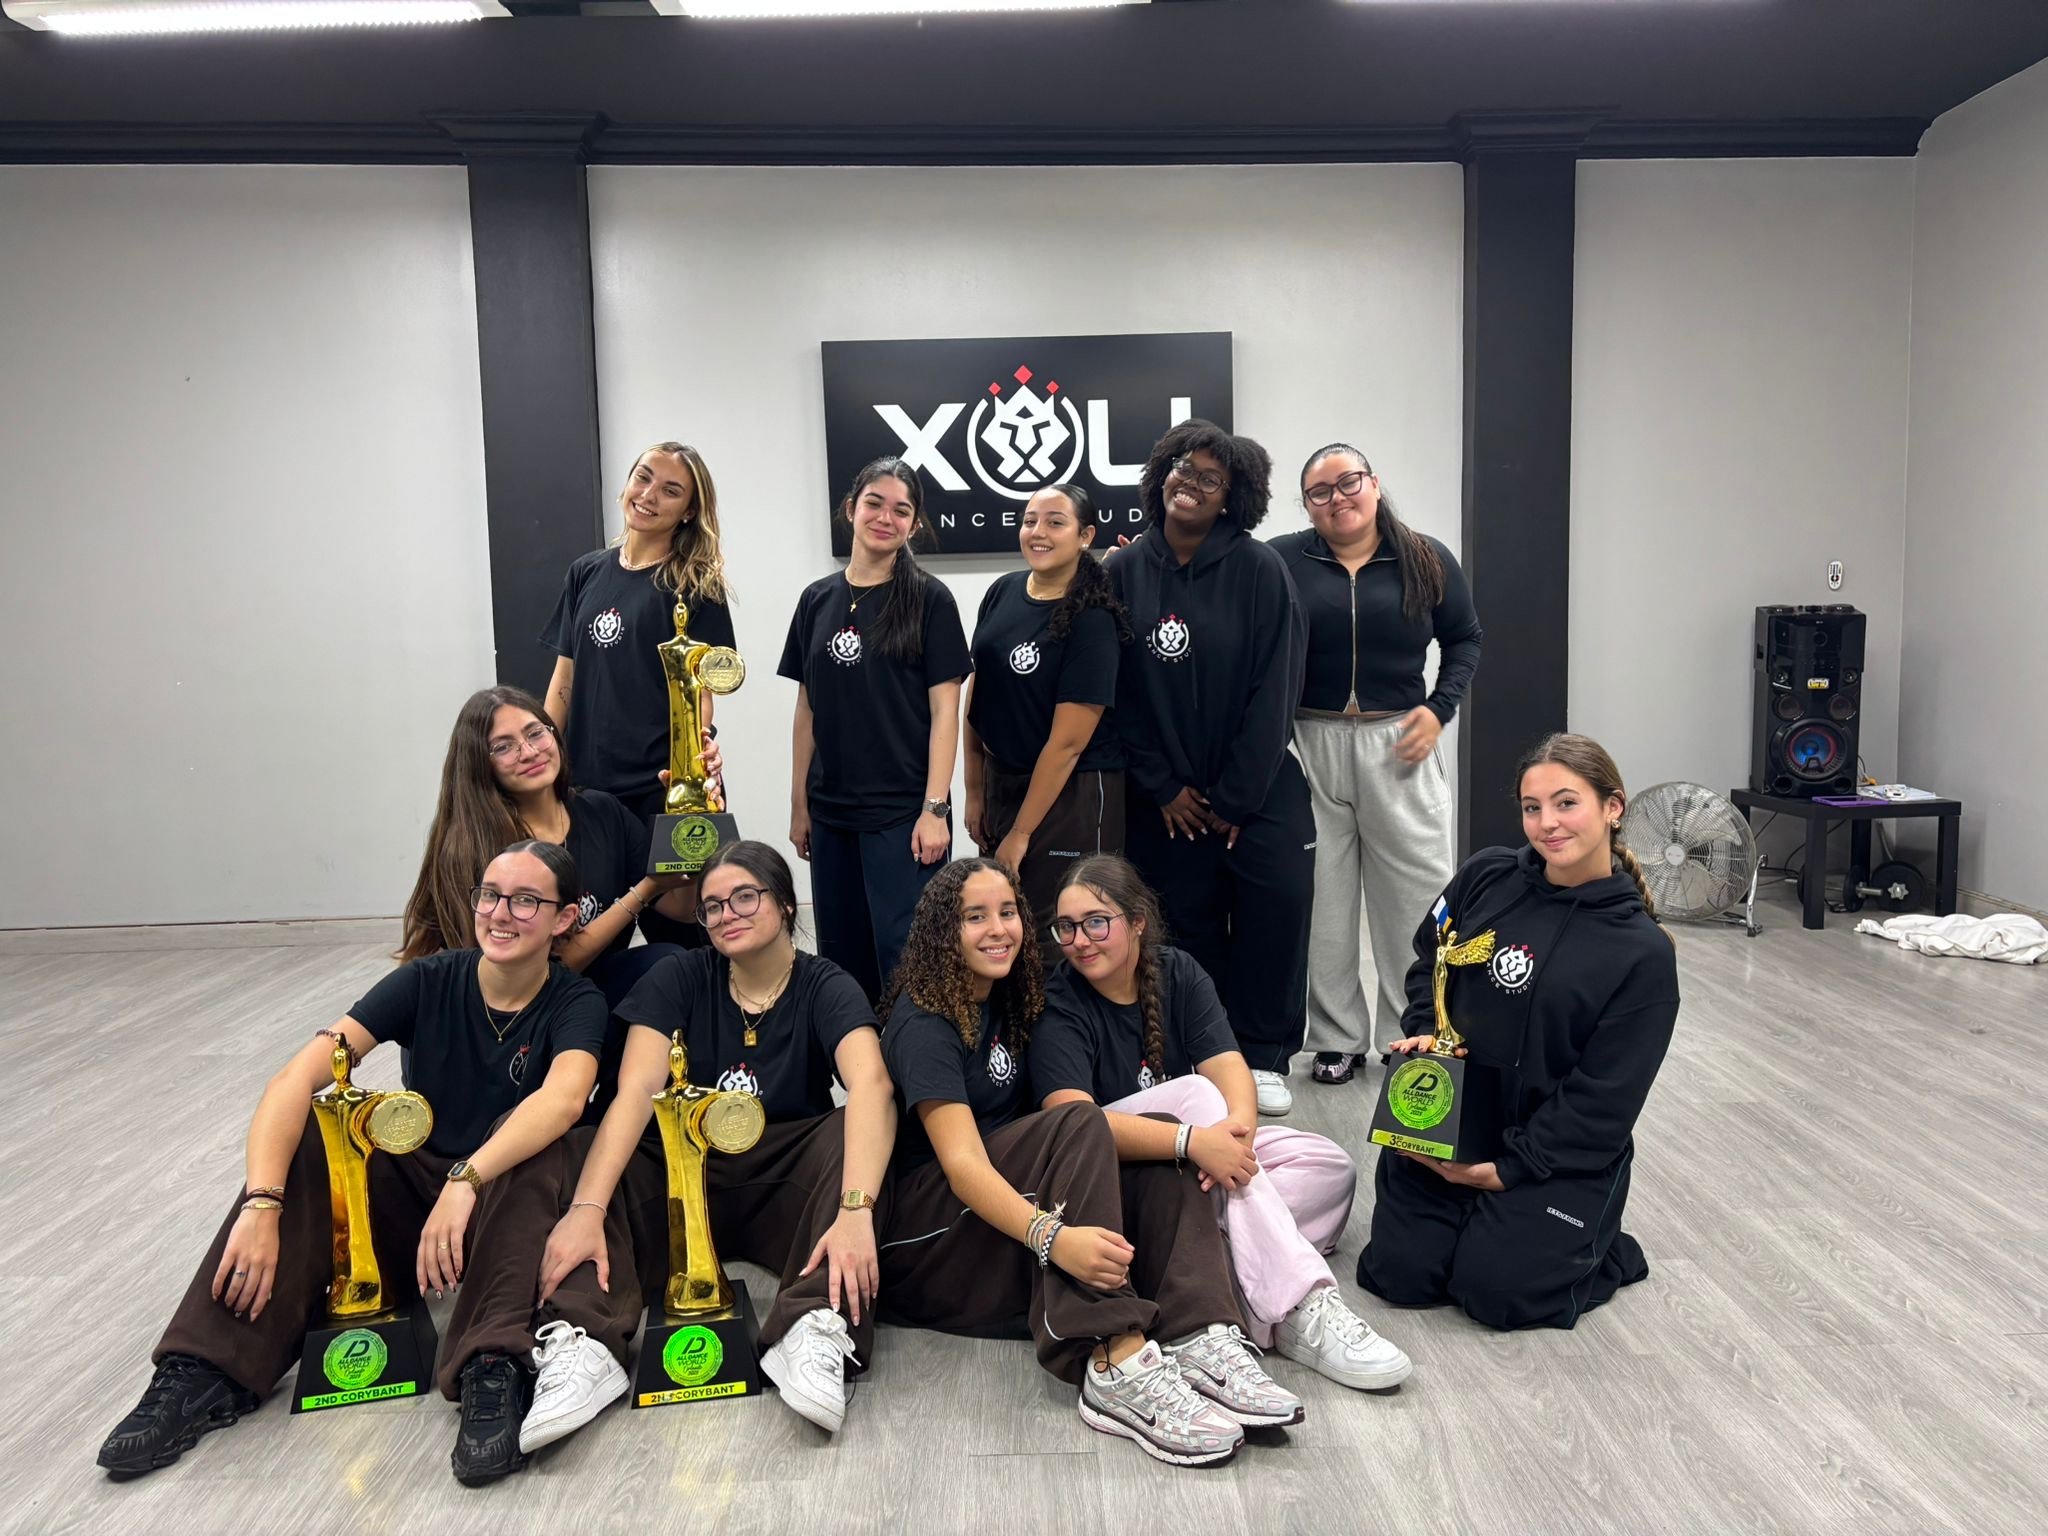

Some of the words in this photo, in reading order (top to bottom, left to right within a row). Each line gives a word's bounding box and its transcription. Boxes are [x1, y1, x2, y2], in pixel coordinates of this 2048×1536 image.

[664, 863, 682, 871] 2ND
[1395, 1140, 1435, 1155] CORYBANT
[314, 1395, 338, 1406] 2ND
[341, 1385, 404, 1404] CORYBANT
[650, 1393, 673, 1403] 2N
[675, 1384, 735, 1400] CORYBANT
